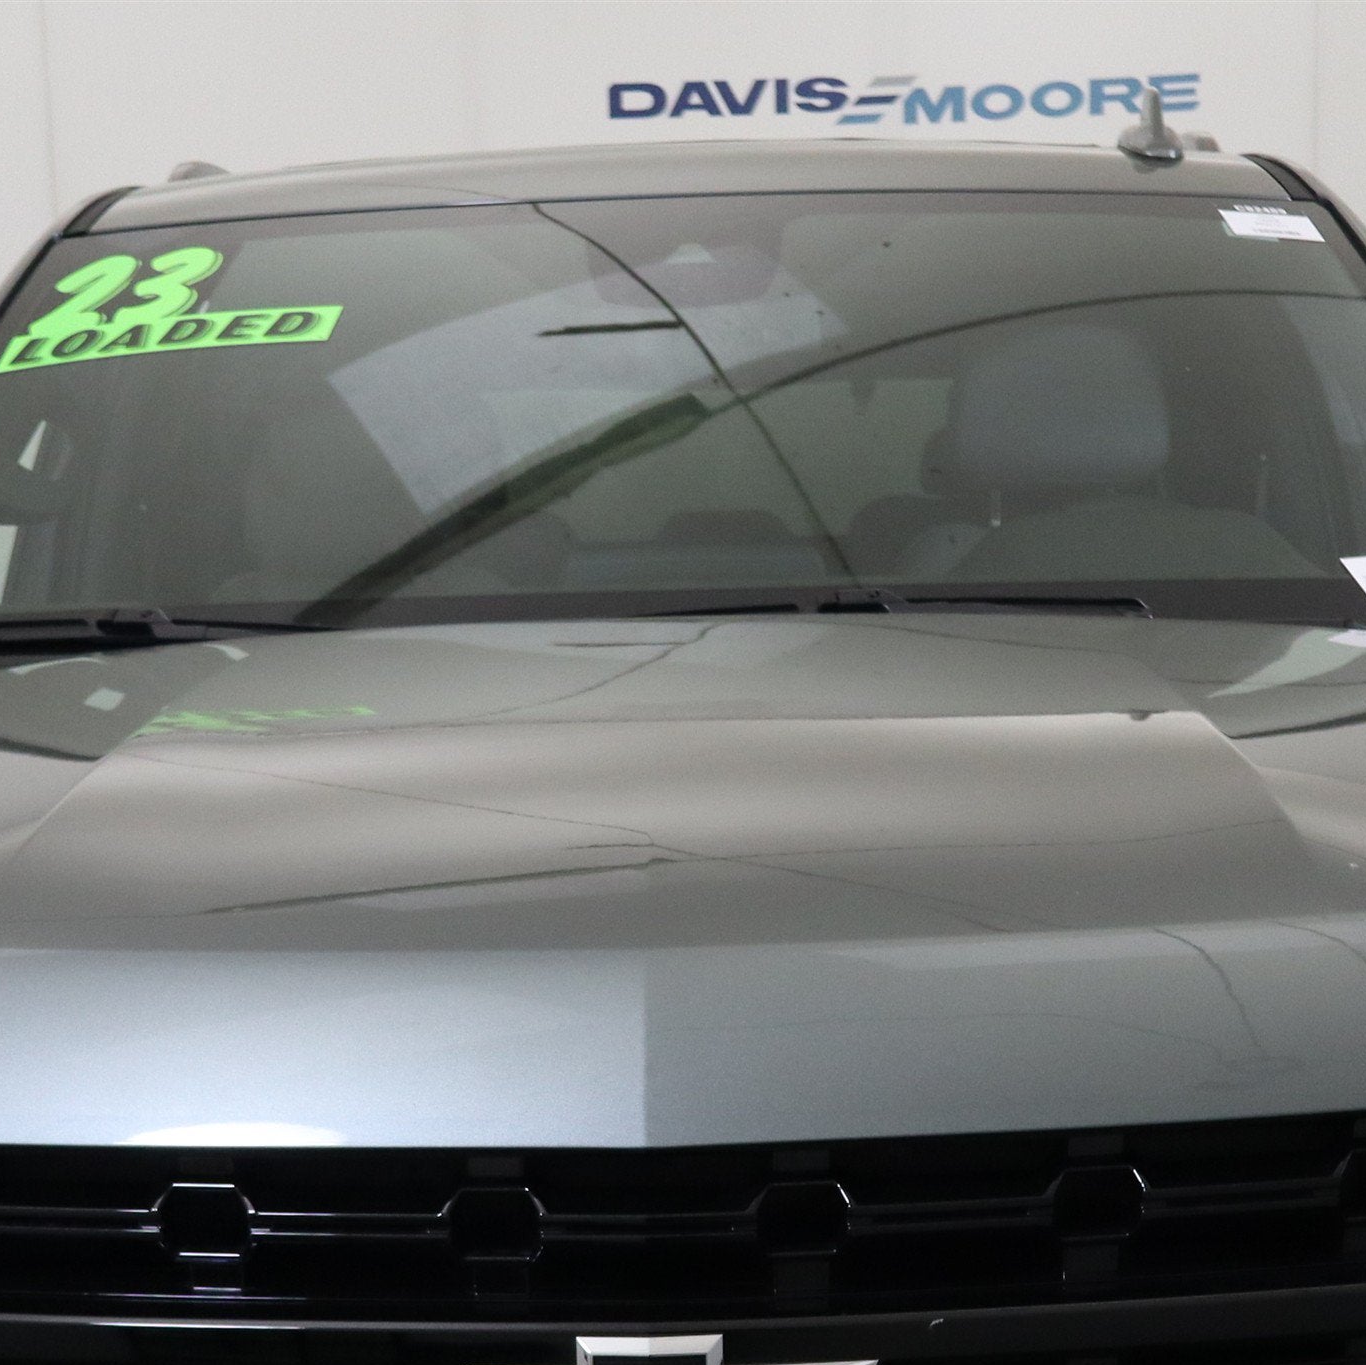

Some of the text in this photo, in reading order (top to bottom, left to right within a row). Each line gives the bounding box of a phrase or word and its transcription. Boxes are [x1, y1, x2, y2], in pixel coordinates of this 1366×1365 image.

[608, 74, 1200, 125] DAVIS MOORE
[28, 246, 223, 335] 23
[10, 311, 320, 365] LOADED
